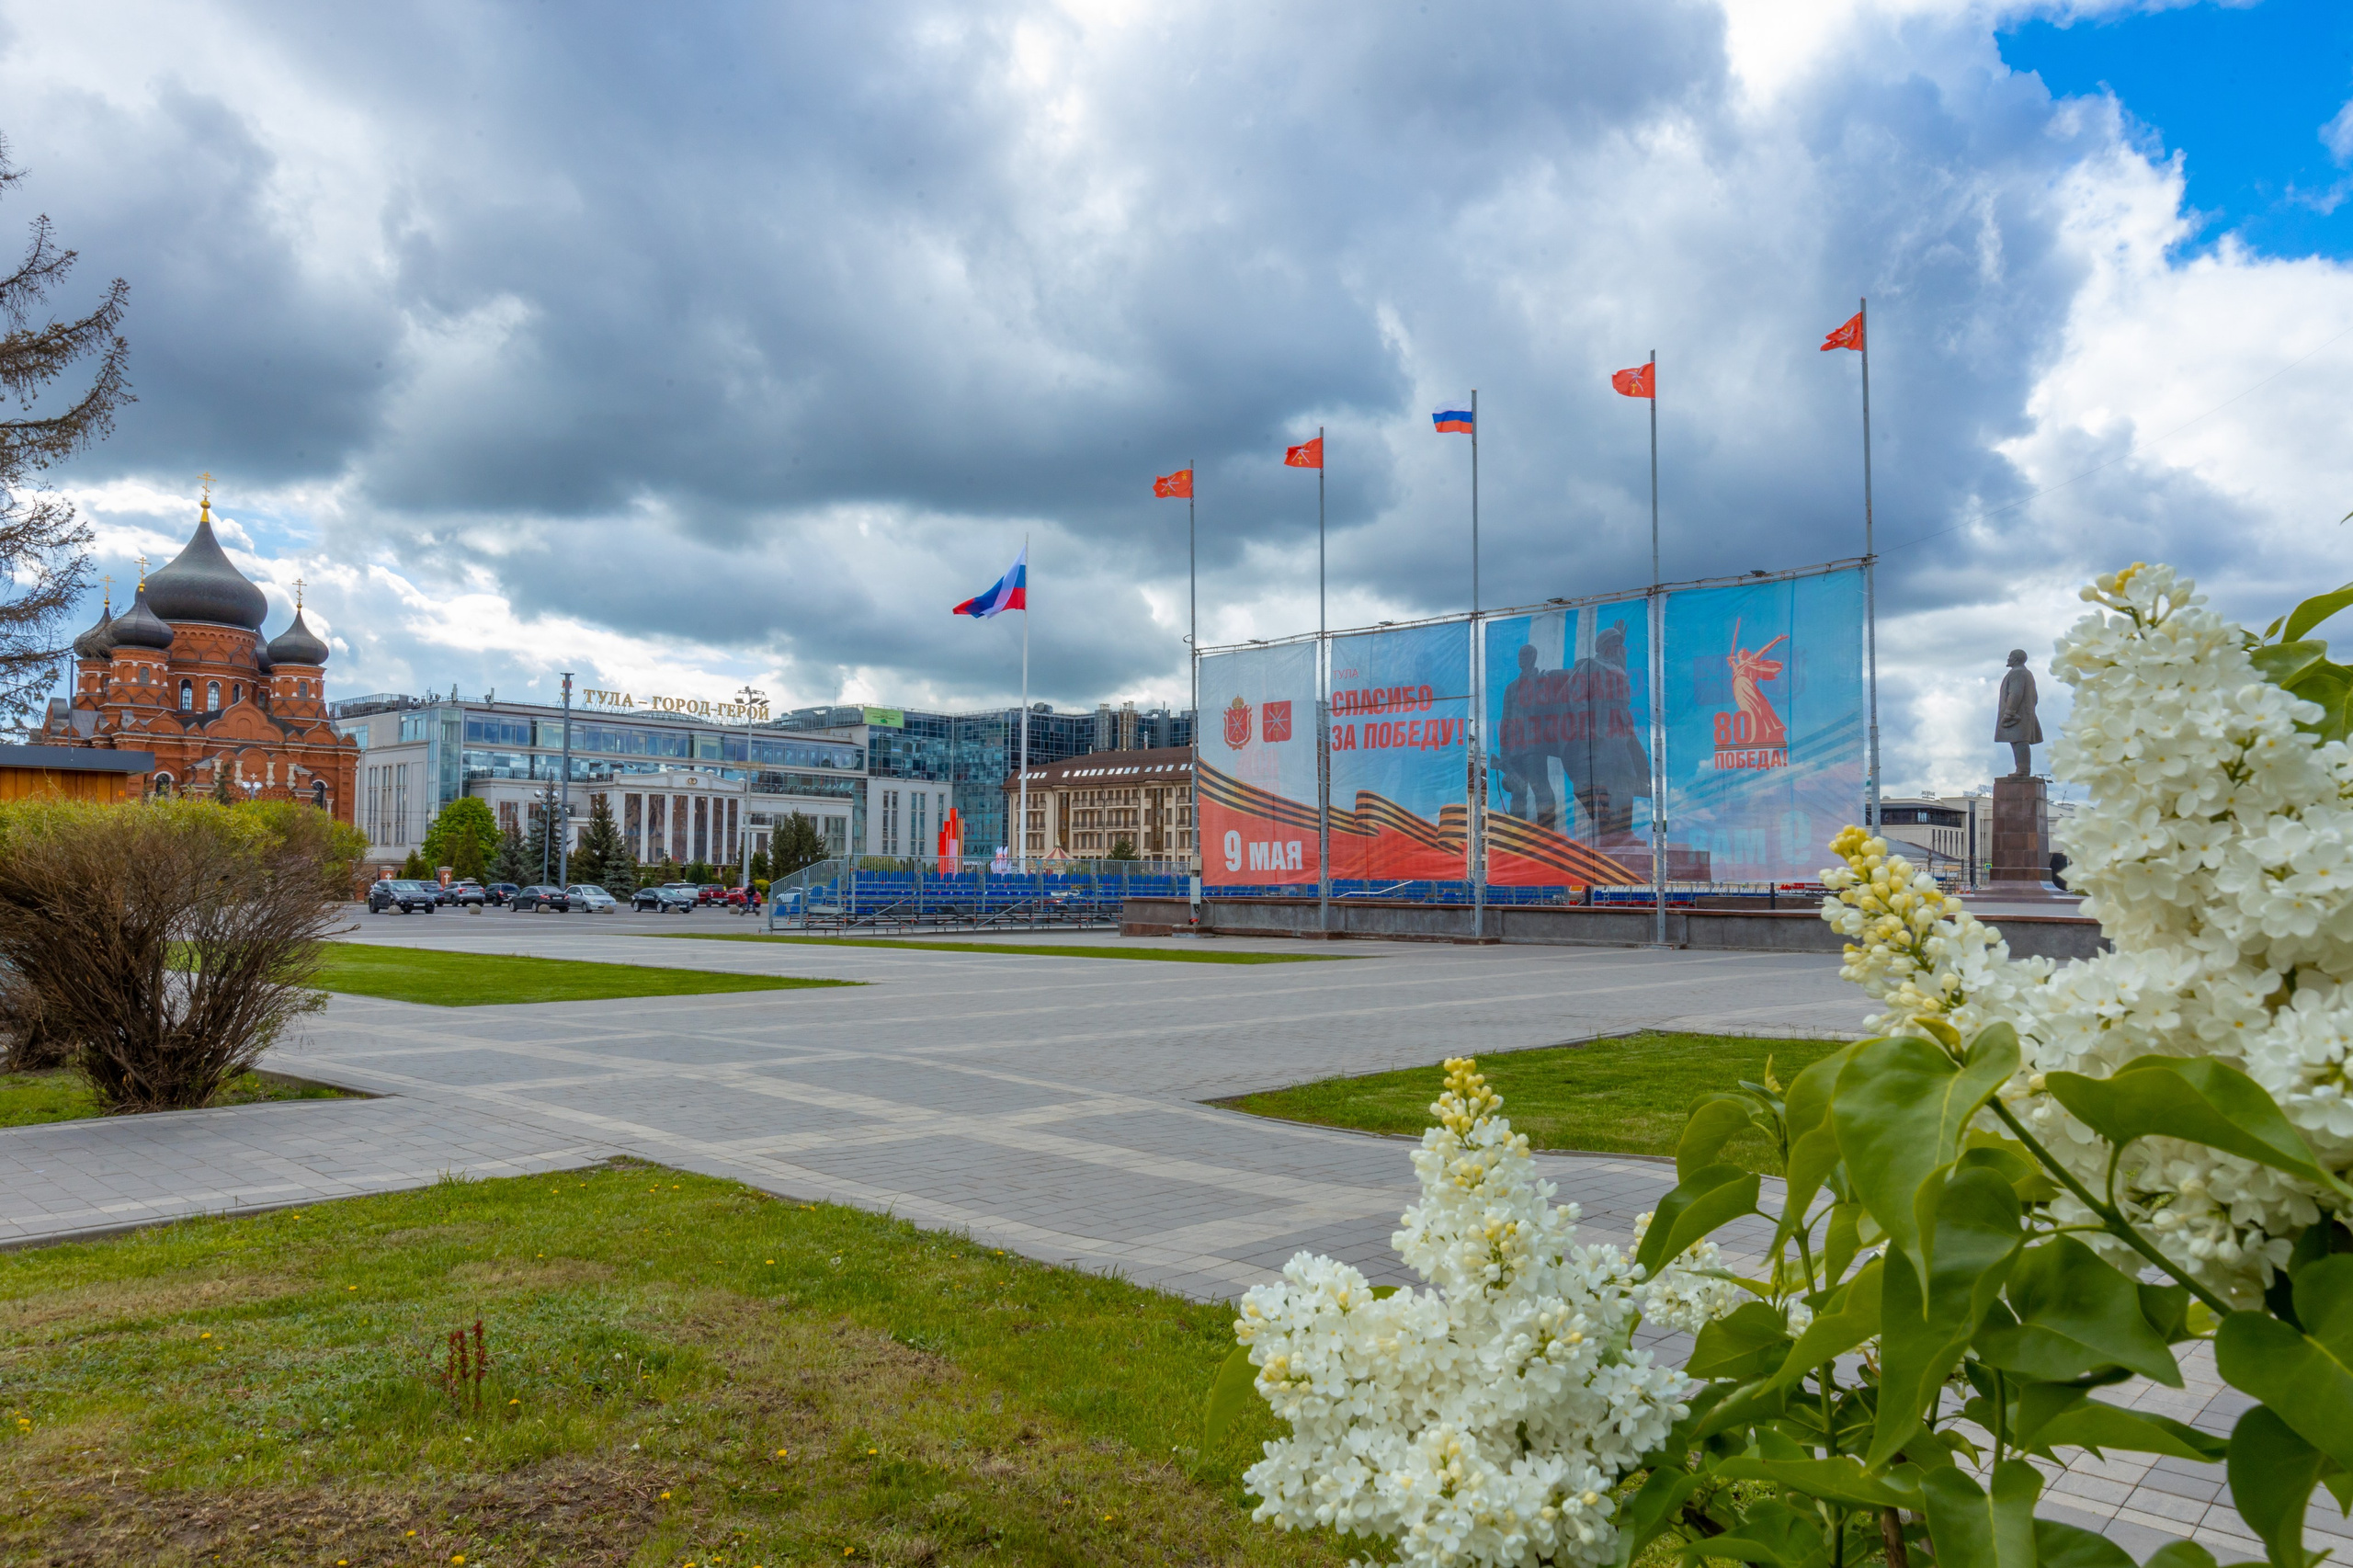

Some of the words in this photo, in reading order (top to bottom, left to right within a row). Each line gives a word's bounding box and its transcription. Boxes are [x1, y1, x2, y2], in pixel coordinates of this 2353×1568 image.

[1333, 668, 1359, 679] ТУЛА
[583, 688, 634, 708] ТУЛА
[1332, 684, 1434, 718] СПАСИБО
[1332, 724, 1357, 752] ЗА
[1363, 718, 1464, 752] ПОБЕДУ!
[1713, 710, 1752, 745] 80
[1714, 749, 1788, 771] ПОБЕДА!
[1223, 830, 1242, 871] 9
[1249, 840, 1303, 871] МАЯ
